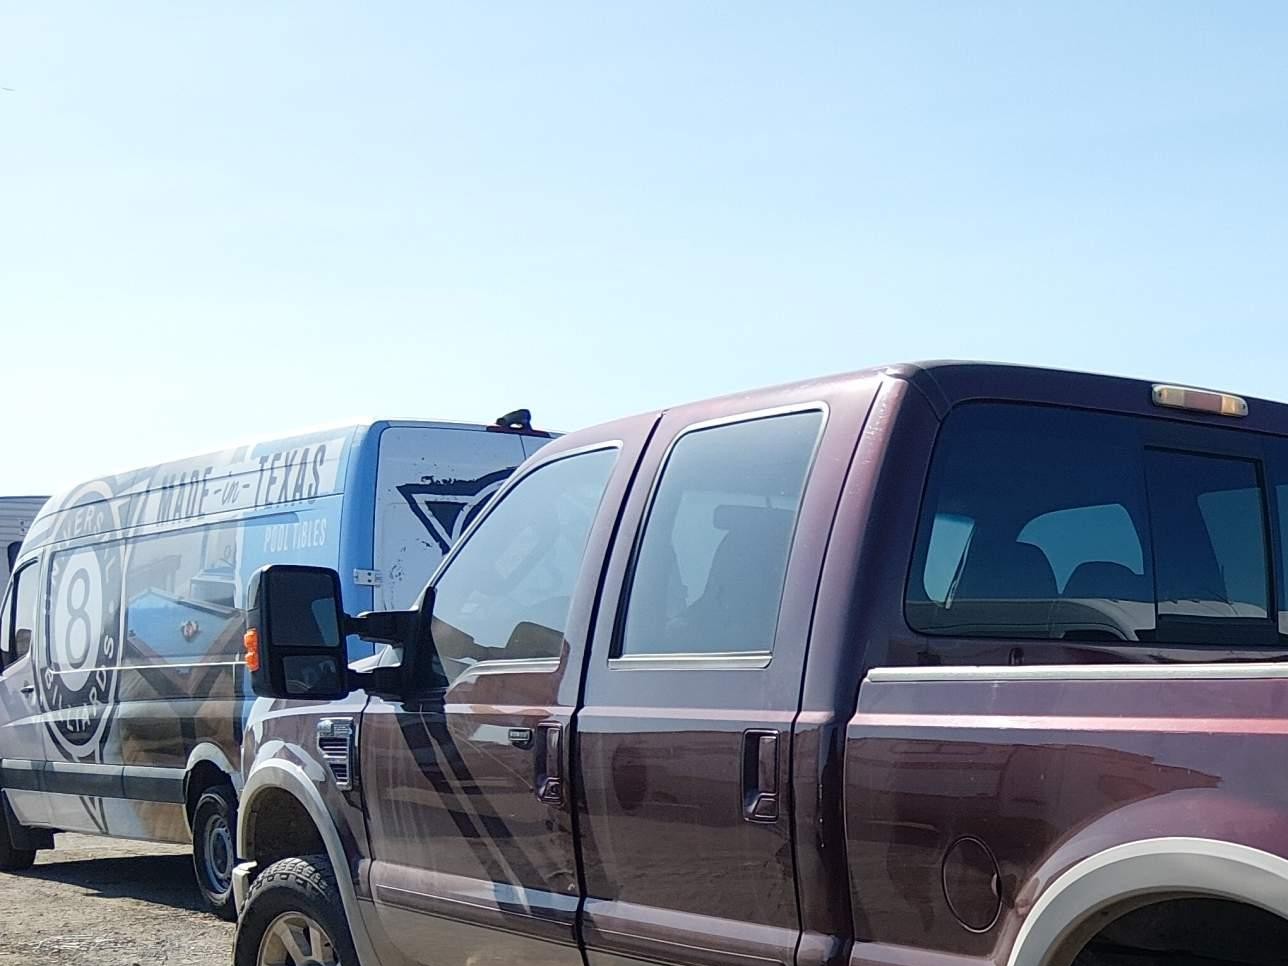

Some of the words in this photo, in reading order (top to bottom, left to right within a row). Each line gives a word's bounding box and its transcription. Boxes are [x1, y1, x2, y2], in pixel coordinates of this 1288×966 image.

[157, 465, 213, 528] MADE
[254, 444, 327, 511] TEXAS
[264, 523, 289, 553] POOL
[293, 517, 328, 550] TABLES
[66, 566, 91, 670] 8
